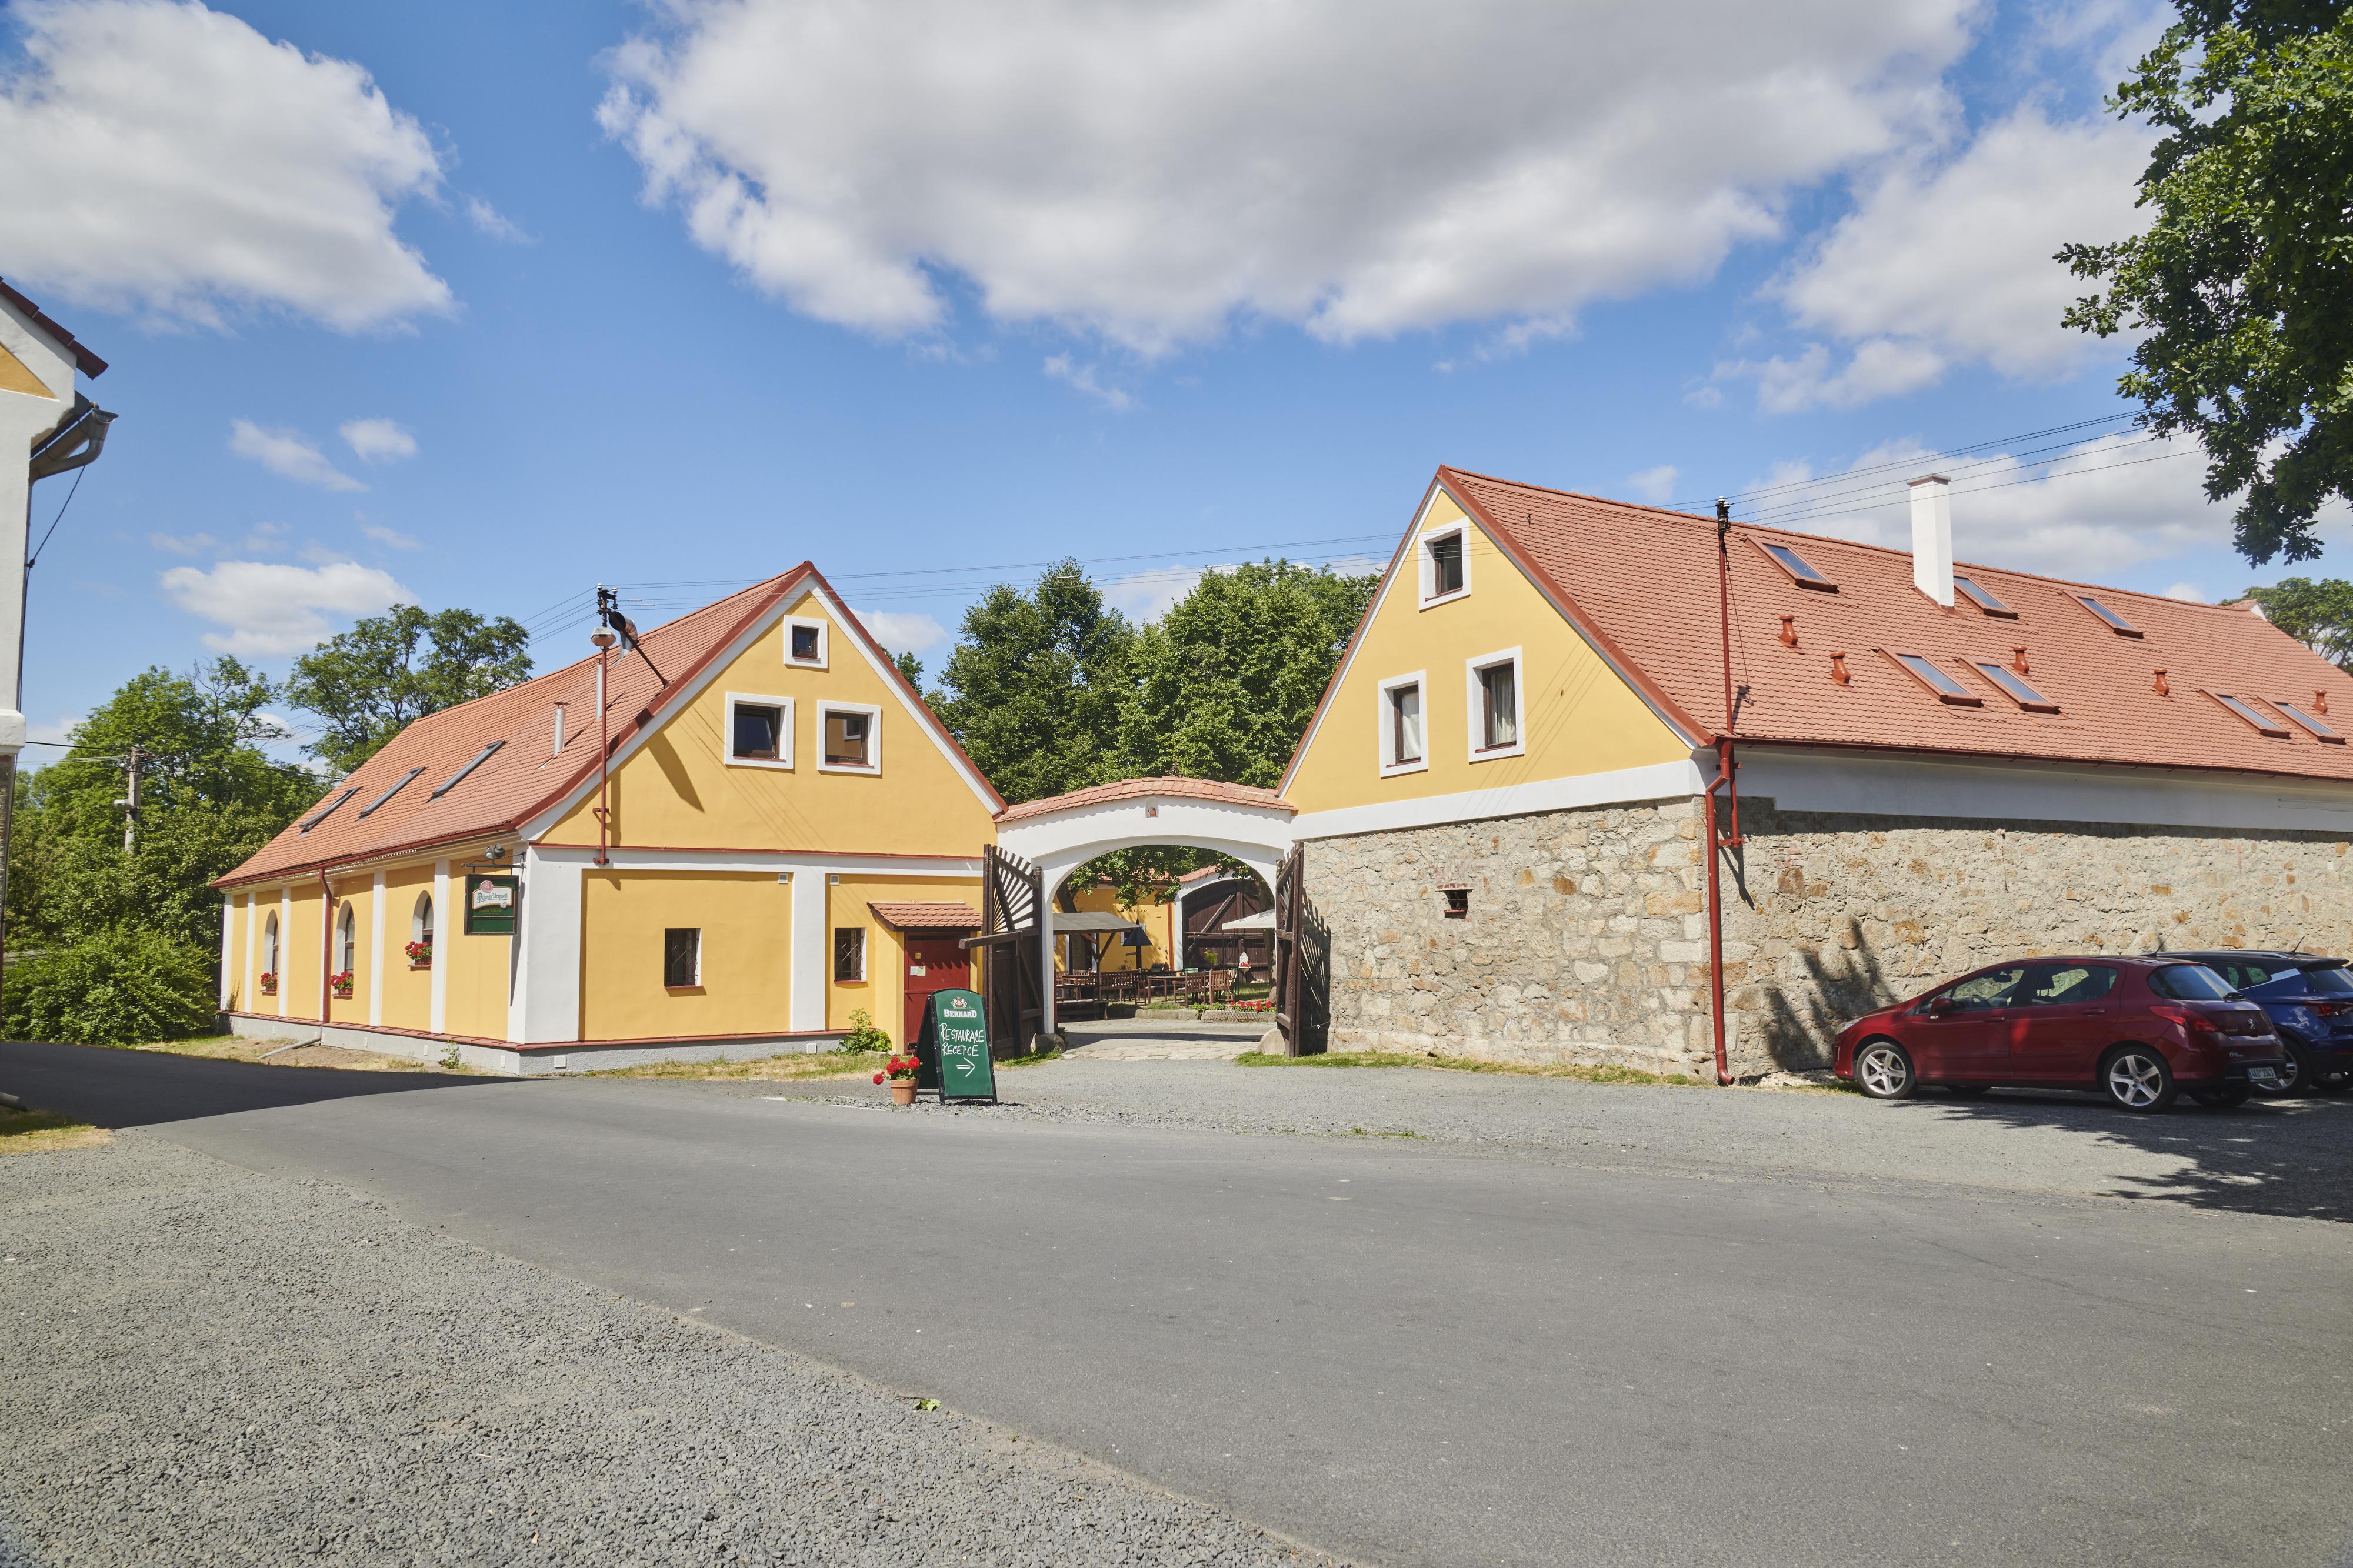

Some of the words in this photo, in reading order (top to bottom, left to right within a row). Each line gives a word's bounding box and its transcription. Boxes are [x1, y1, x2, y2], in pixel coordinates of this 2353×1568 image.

[944, 1009, 977, 1018] BERNARD
[939, 1023, 984, 1043] RESTAURACE
[942, 1042, 979, 1056] RECEPCE
